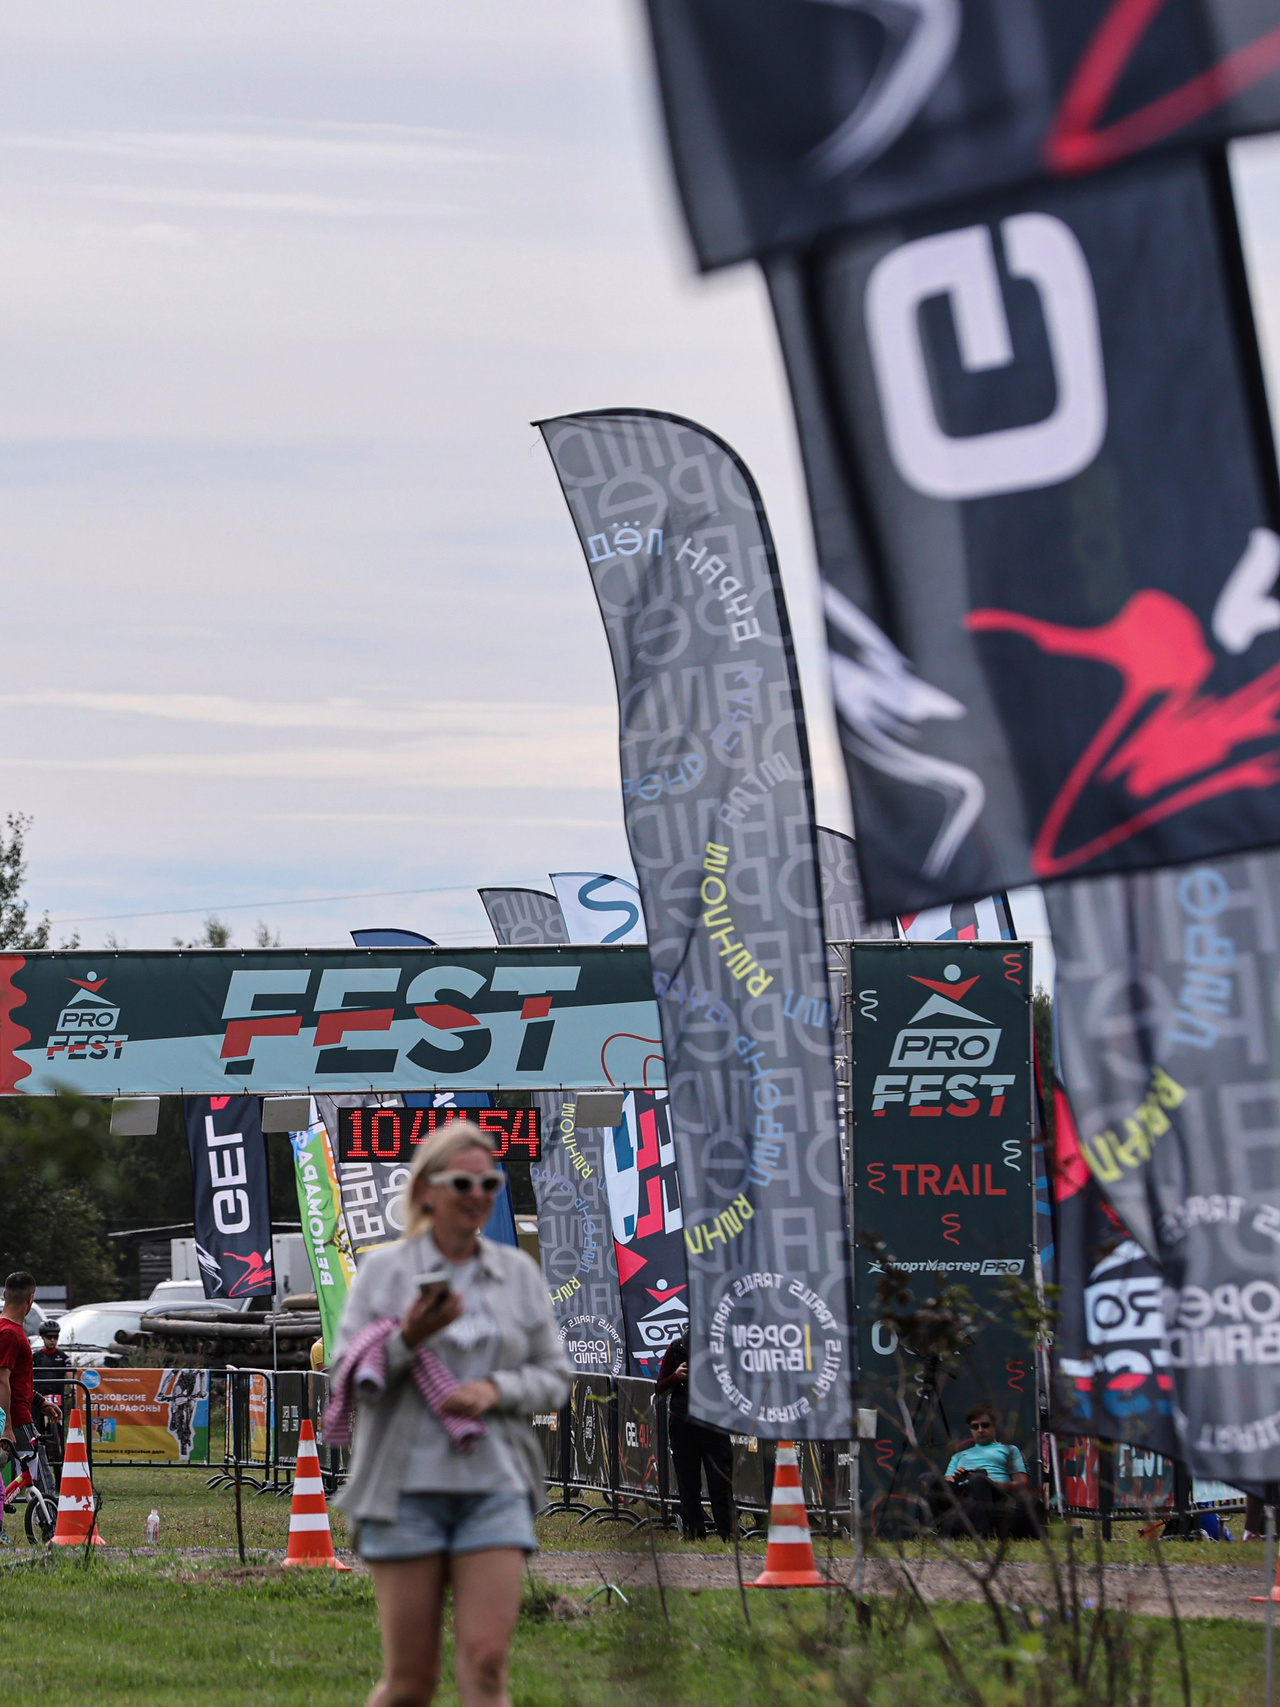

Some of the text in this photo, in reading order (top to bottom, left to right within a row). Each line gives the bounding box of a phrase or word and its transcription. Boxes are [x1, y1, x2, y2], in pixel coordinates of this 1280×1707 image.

[62, 1012, 114, 1028] PRO
[220, 966, 581, 1075] FEST
[47, 1035, 129, 1060] FEST
[898, 1035, 991, 1061] PRO
[871, 1074, 1017, 1117] FEST
[892, 1163, 1008, 1196] TRAIL
[984, 1262, 1020, 1273] PRO
